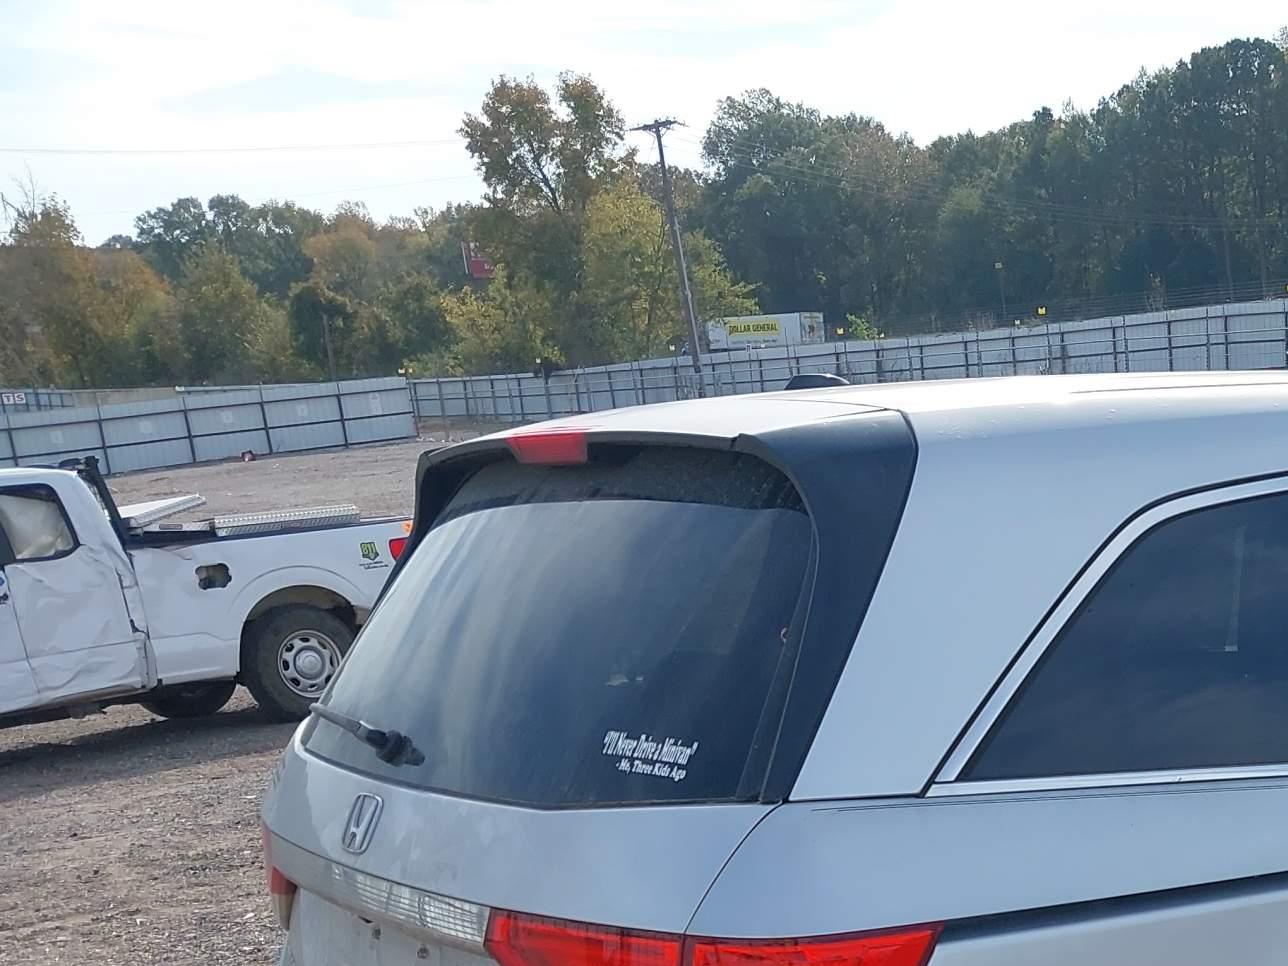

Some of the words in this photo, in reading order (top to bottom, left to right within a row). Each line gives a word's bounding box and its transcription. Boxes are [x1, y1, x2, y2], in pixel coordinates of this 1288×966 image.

[613, 732, 638, 757] Never
[633, 734, 657, 760] Drive
[653, 743, 662, 761] a
[631, 760, 654, 775] Three
[652, 762, 672, 778] Kids
[669, 765, 687, 782] Ago
